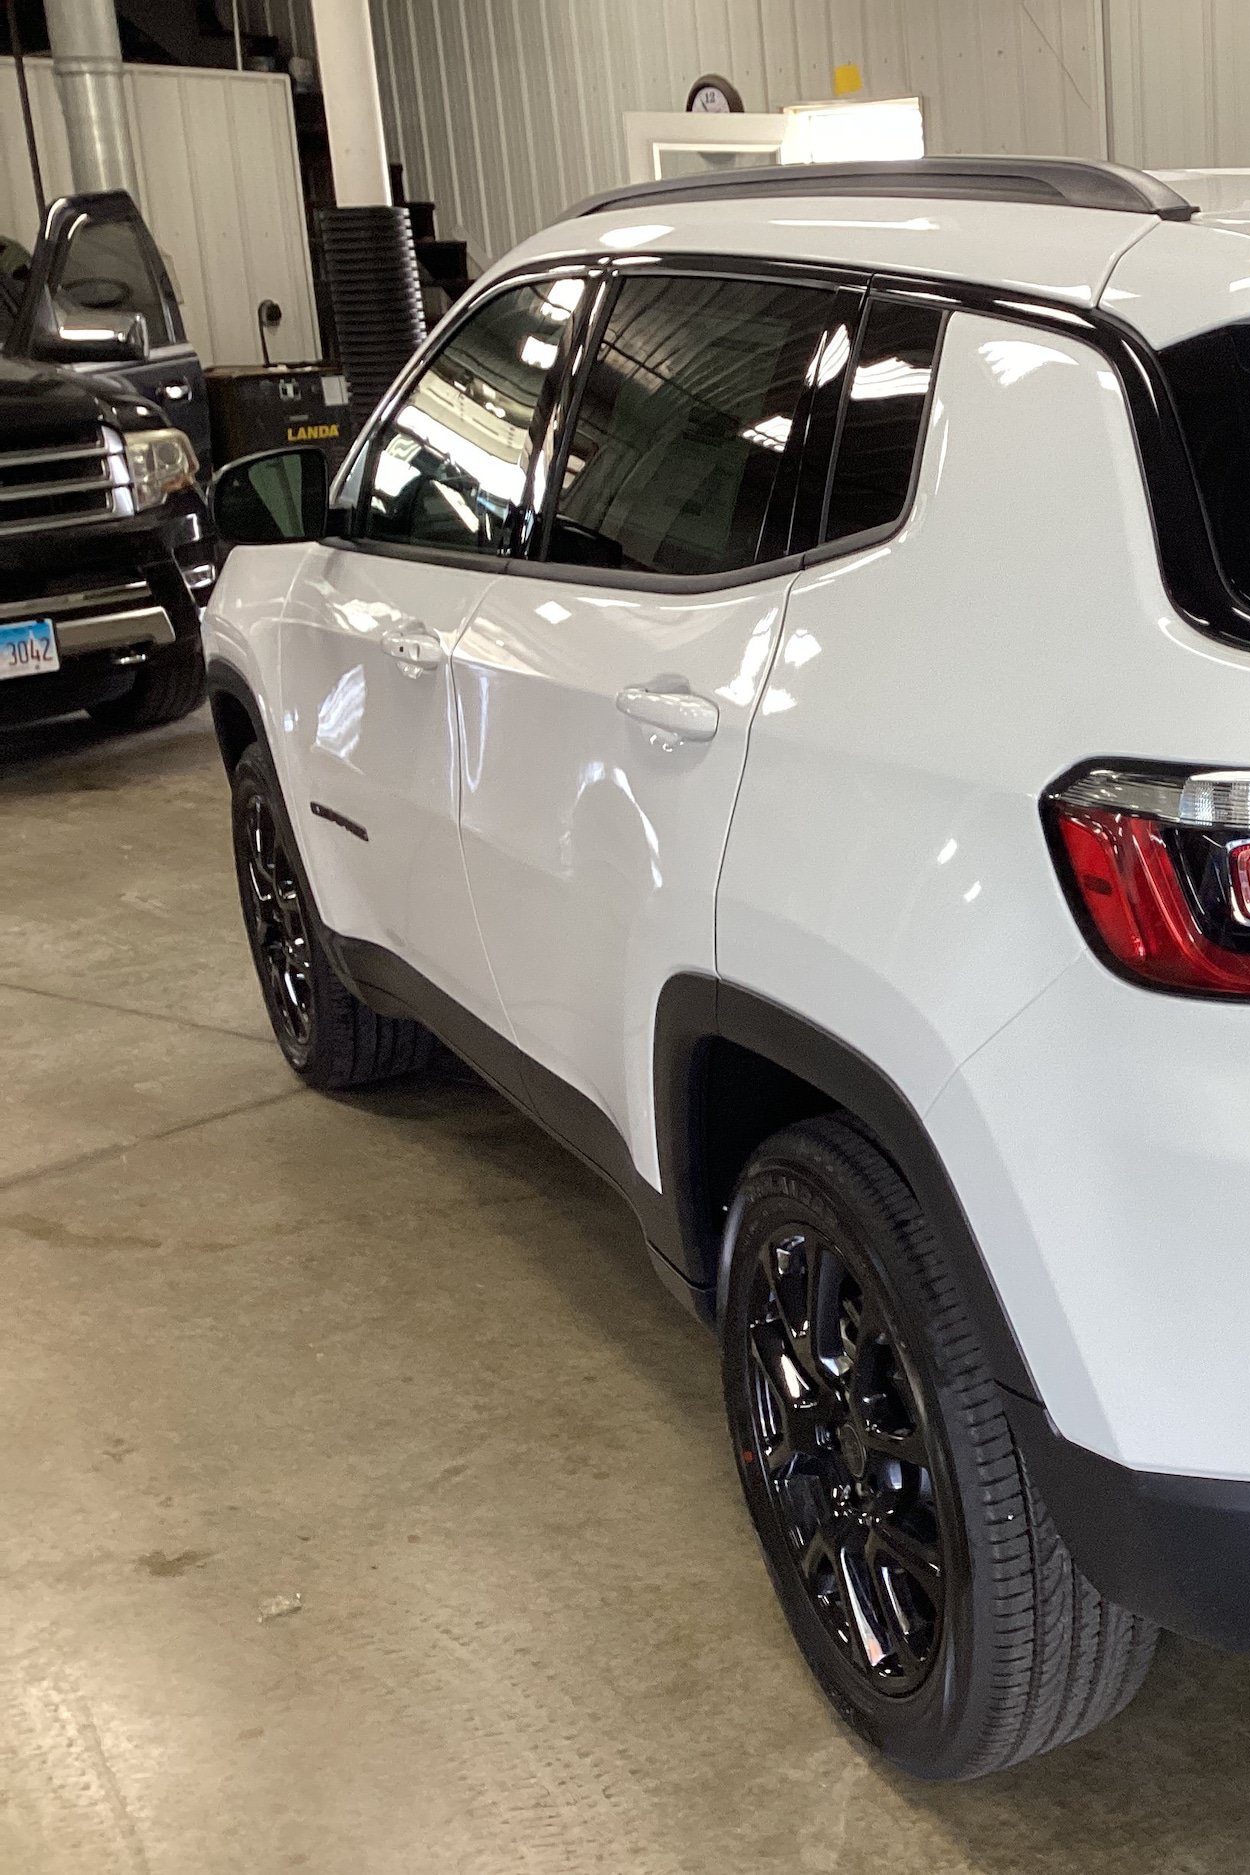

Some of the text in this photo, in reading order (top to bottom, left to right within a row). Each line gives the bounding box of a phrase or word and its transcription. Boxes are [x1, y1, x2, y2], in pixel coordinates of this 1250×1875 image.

[705, 91, 716, 104] 12
[287, 424, 339, 442] LANDA
[6, 637, 53, 666] 3042
